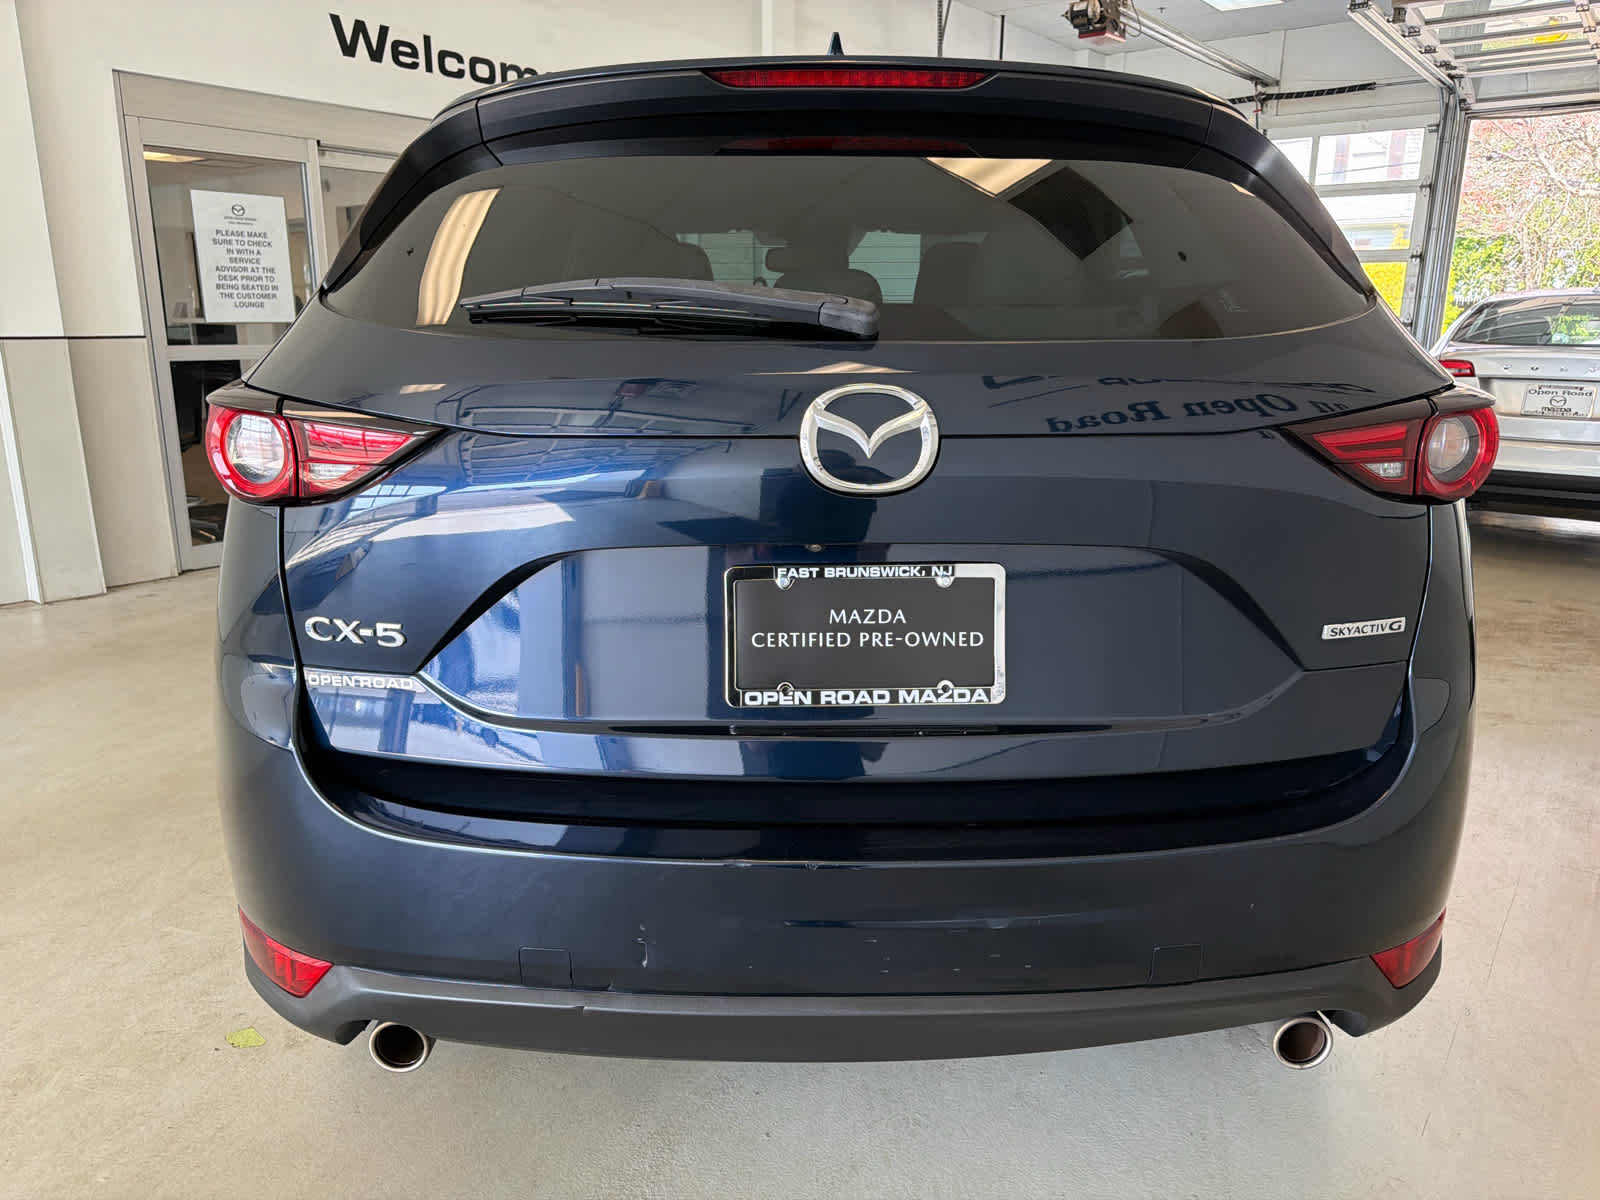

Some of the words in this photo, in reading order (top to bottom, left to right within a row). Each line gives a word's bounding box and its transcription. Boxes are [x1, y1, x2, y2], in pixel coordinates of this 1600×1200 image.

[329, 13, 540, 85] Welcom
[216, 229, 245, 237] PLEASE
[216, 265, 248, 273] ADVISOR
[234, 301, 264, 309] LOUNGE
[1528, 388, 1558, 397] Open
[1562, 389, 1593, 397] Road
[777, 567, 819, 578] EAST
[824, 566, 926, 578] BRUNSWICK,
[932, 566, 952, 577] NJ
[829, 609, 907, 624] MAZDA
[304, 616, 406, 648] CX-5
[751, 632, 851, 648] CERTIFIED
[859, 631, 984, 647] PRE-OWNED
[744, 691, 812, 705] OPEN
[820, 690, 890, 705] ROAD
